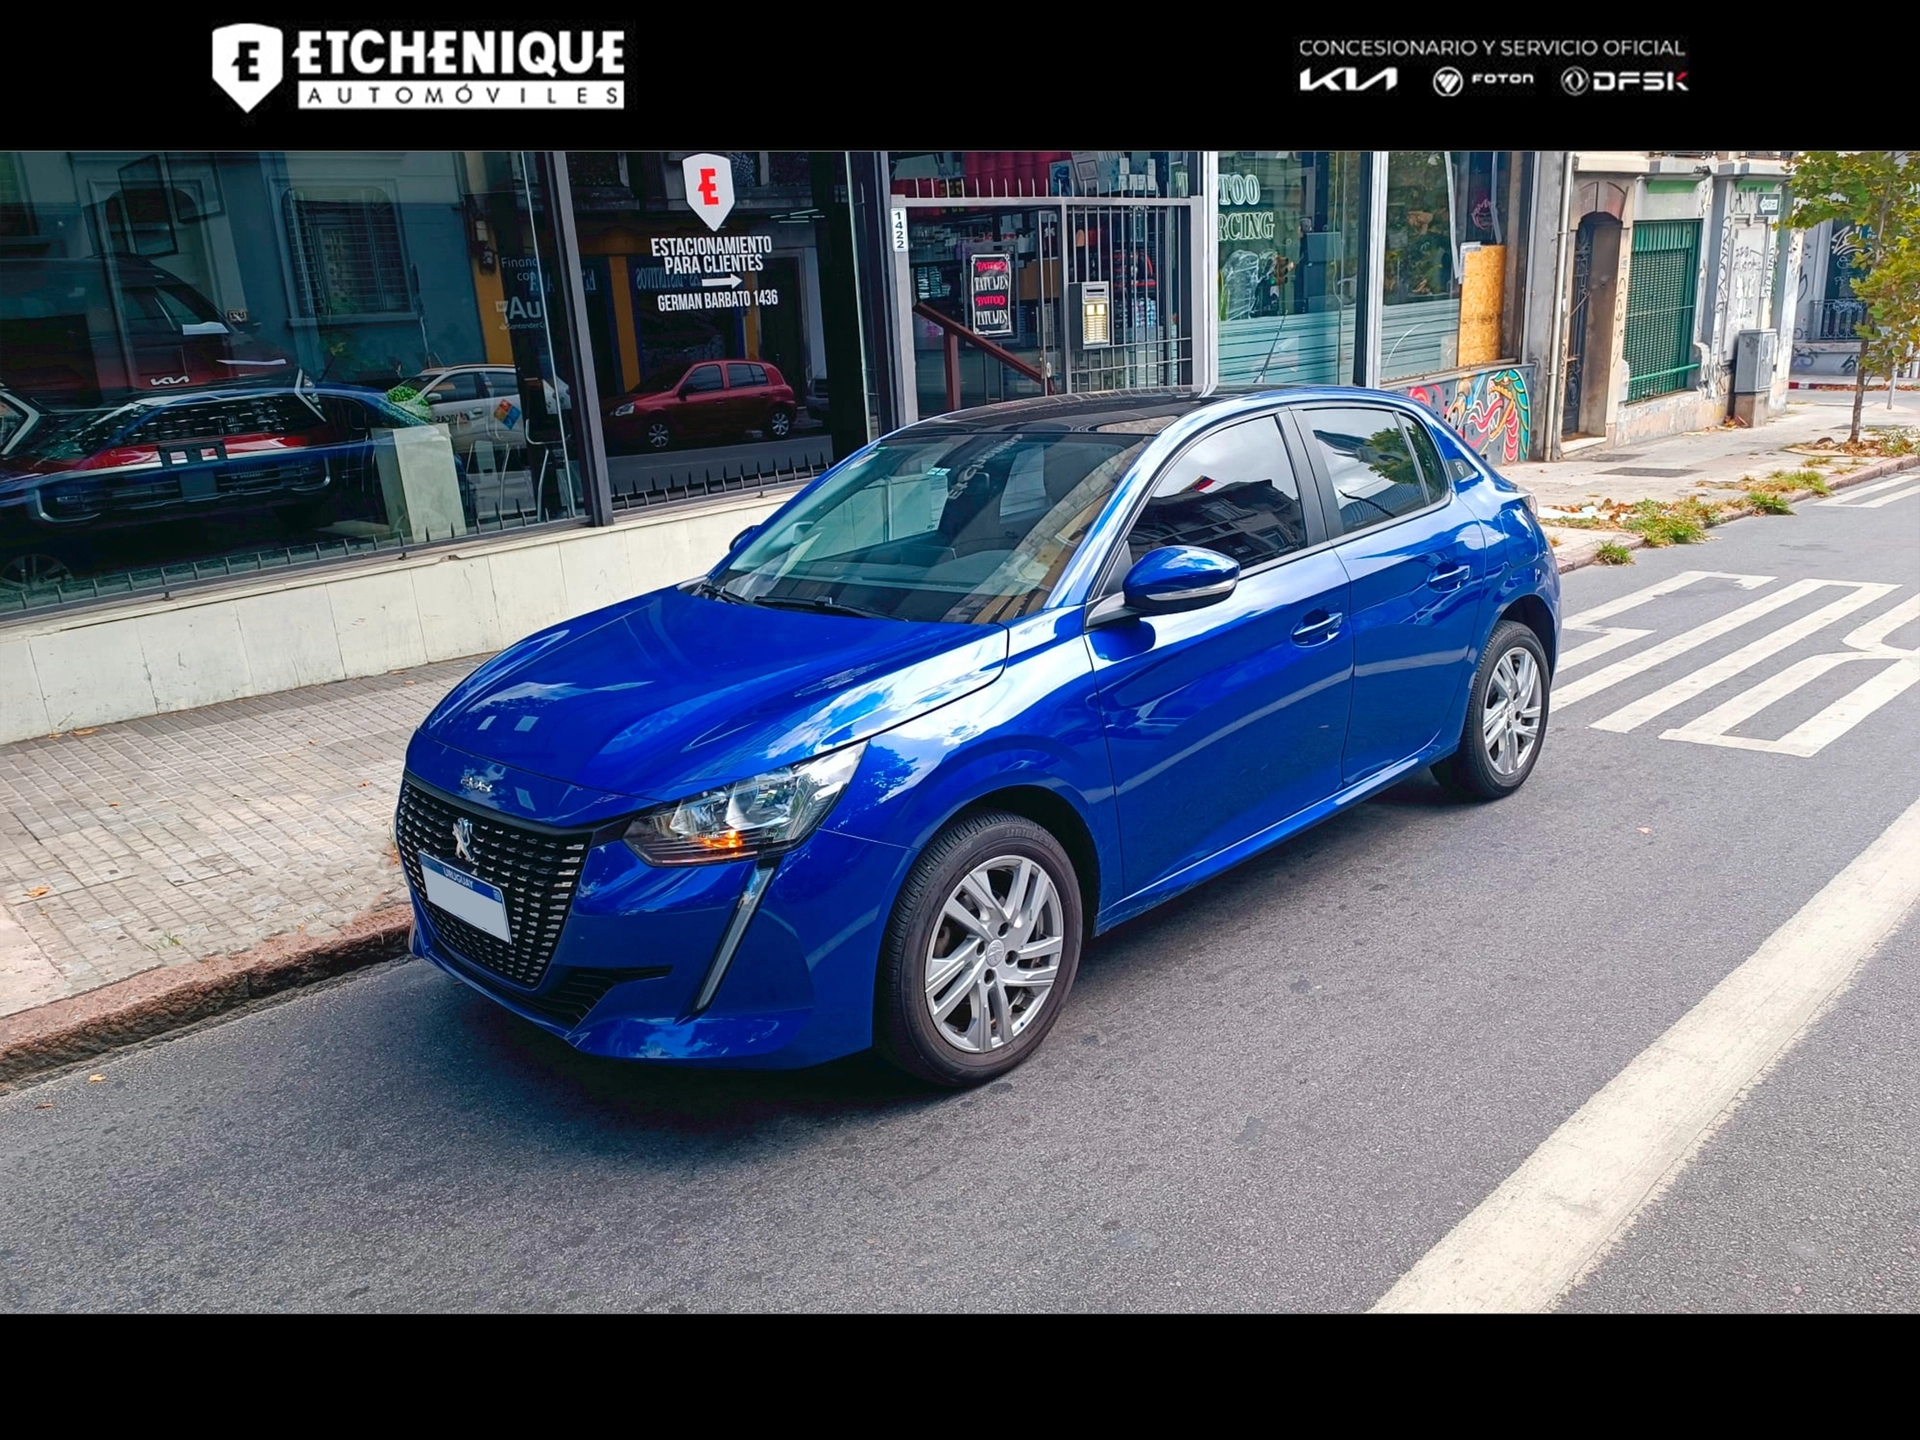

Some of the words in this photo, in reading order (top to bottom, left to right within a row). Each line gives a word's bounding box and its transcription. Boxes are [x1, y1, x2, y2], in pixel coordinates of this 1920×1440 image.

[1218, 173, 1261, 206] TOO
[894, 211, 905, 249] 1422
[1217, 211, 1275, 241] RCING
[650, 236, 772, 257] ESTACIONAMIENTO
[501, 256, 540, 269] Financ
[664, 255, 701, 275] PARA
[703, 254, 764, 273] CLIENTES
[508, 296, 543, 320] Au
[657, 292, 703, 312] GERMAN
[704, 290, 751, 309] BARBATO
[753, 289, 778, 306] 1436
[442, 866, 474, 890] URUGUAY
